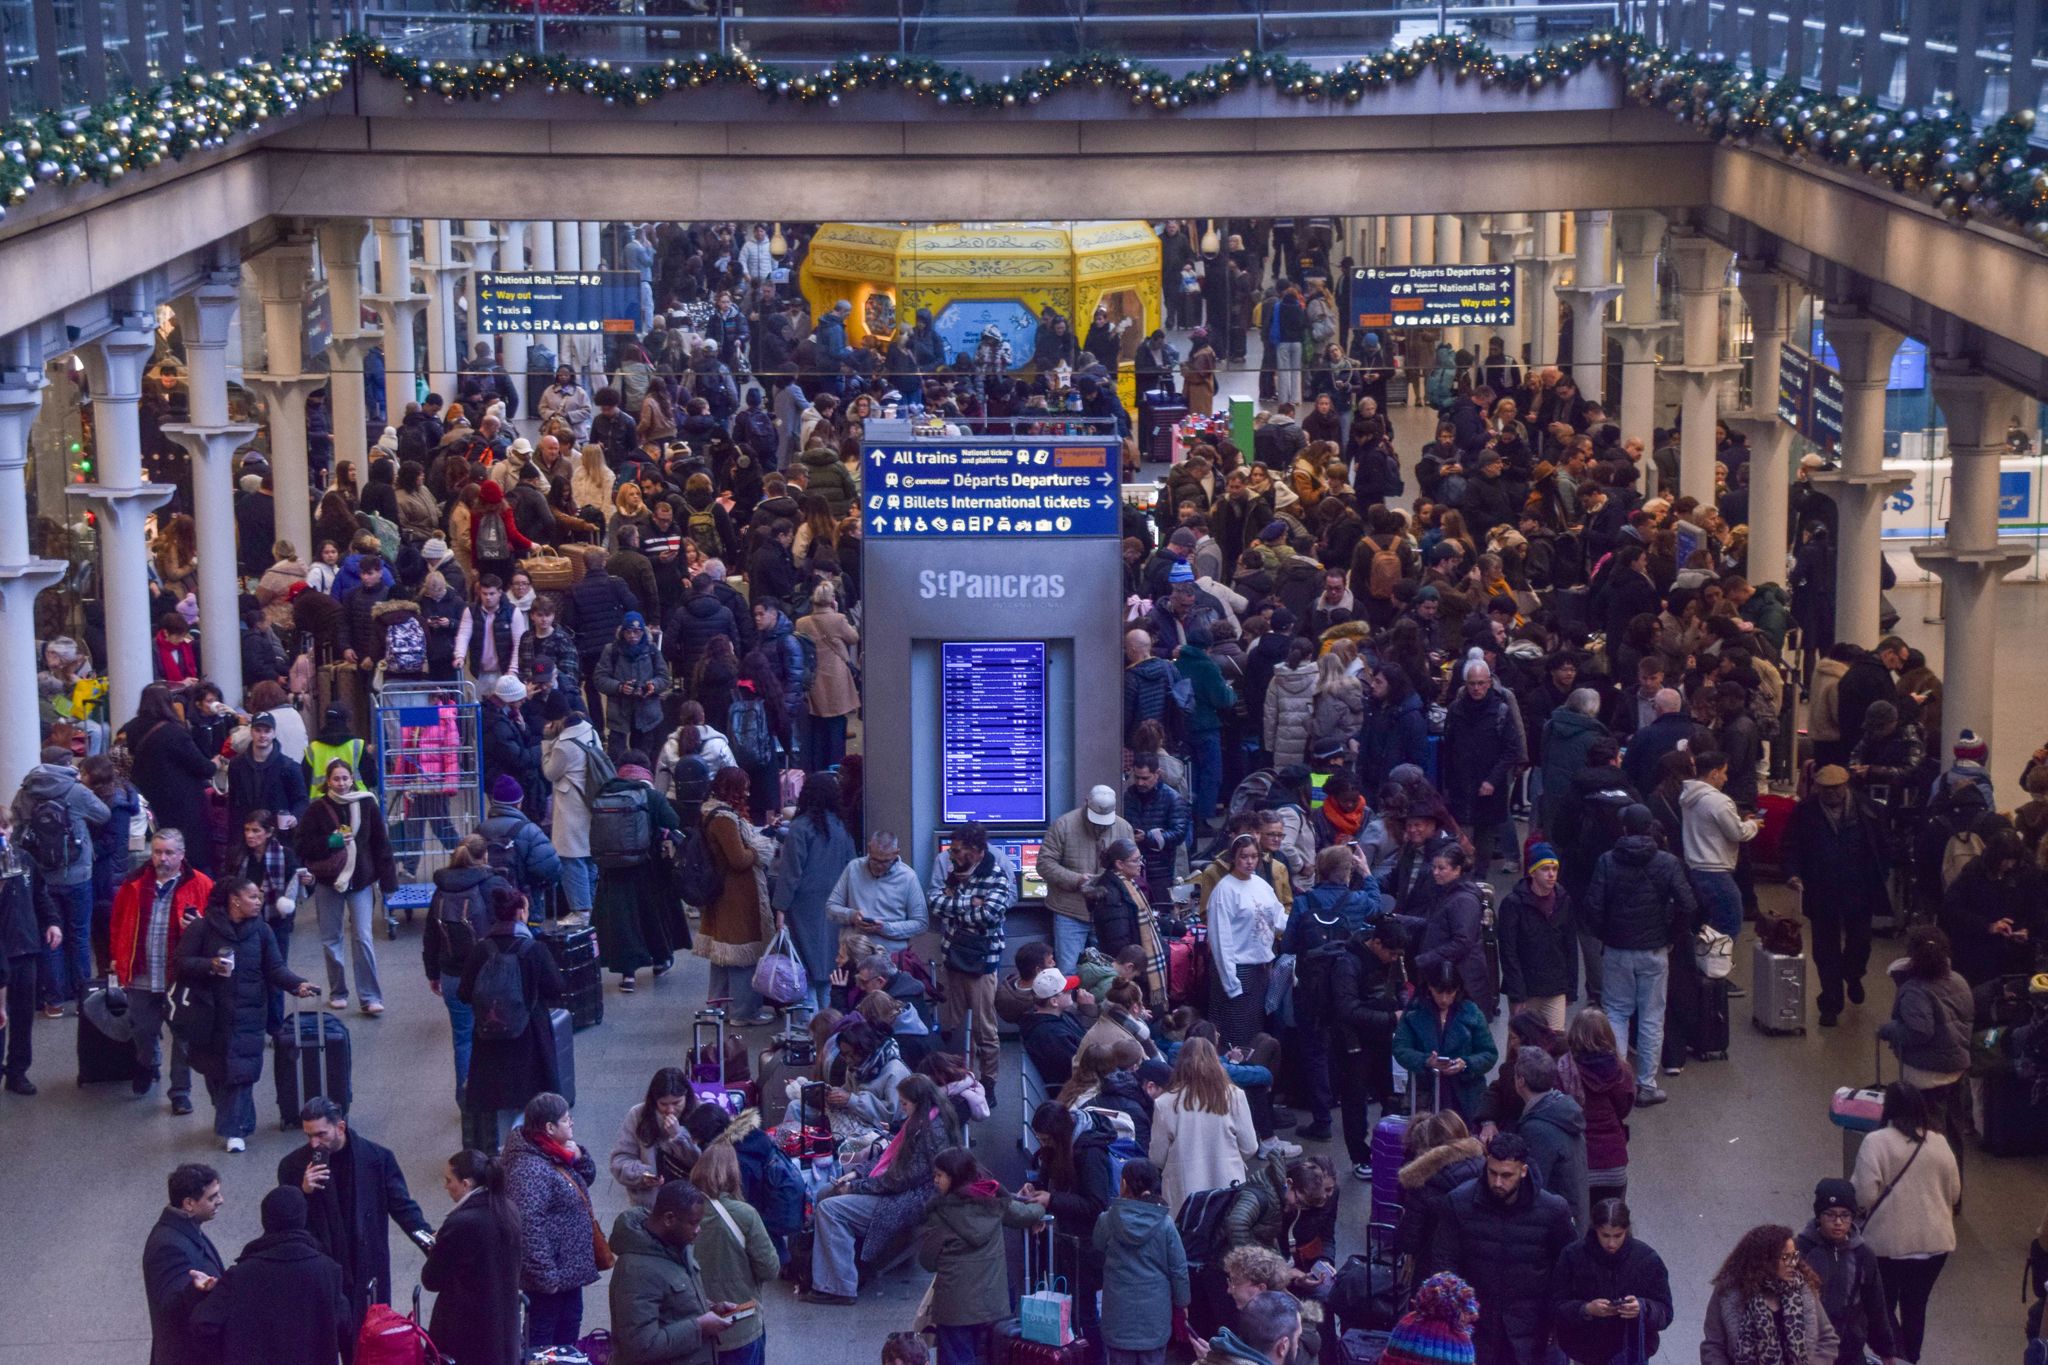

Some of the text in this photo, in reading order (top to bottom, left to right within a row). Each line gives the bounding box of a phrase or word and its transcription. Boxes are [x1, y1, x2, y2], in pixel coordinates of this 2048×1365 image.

[1410, 268, 1445, 279] Départs
[1446, 267, 1496, 278] Departures
[495, 275, 552, 285] National Rail
[1439, 282, 1496, 293] National Rail
[496, 291, 532, 301] Way out
[1460, 298, 1497, 309] Way out
[496, 305, 521, 315] Taxis
[893, 450, 958, 464] All trains
[975, 457, 1008, 465] platforms
[914, 472, 1091, 489] eurostar Départs Departures
[903, 495, 1091, 509] Billets International tickets
